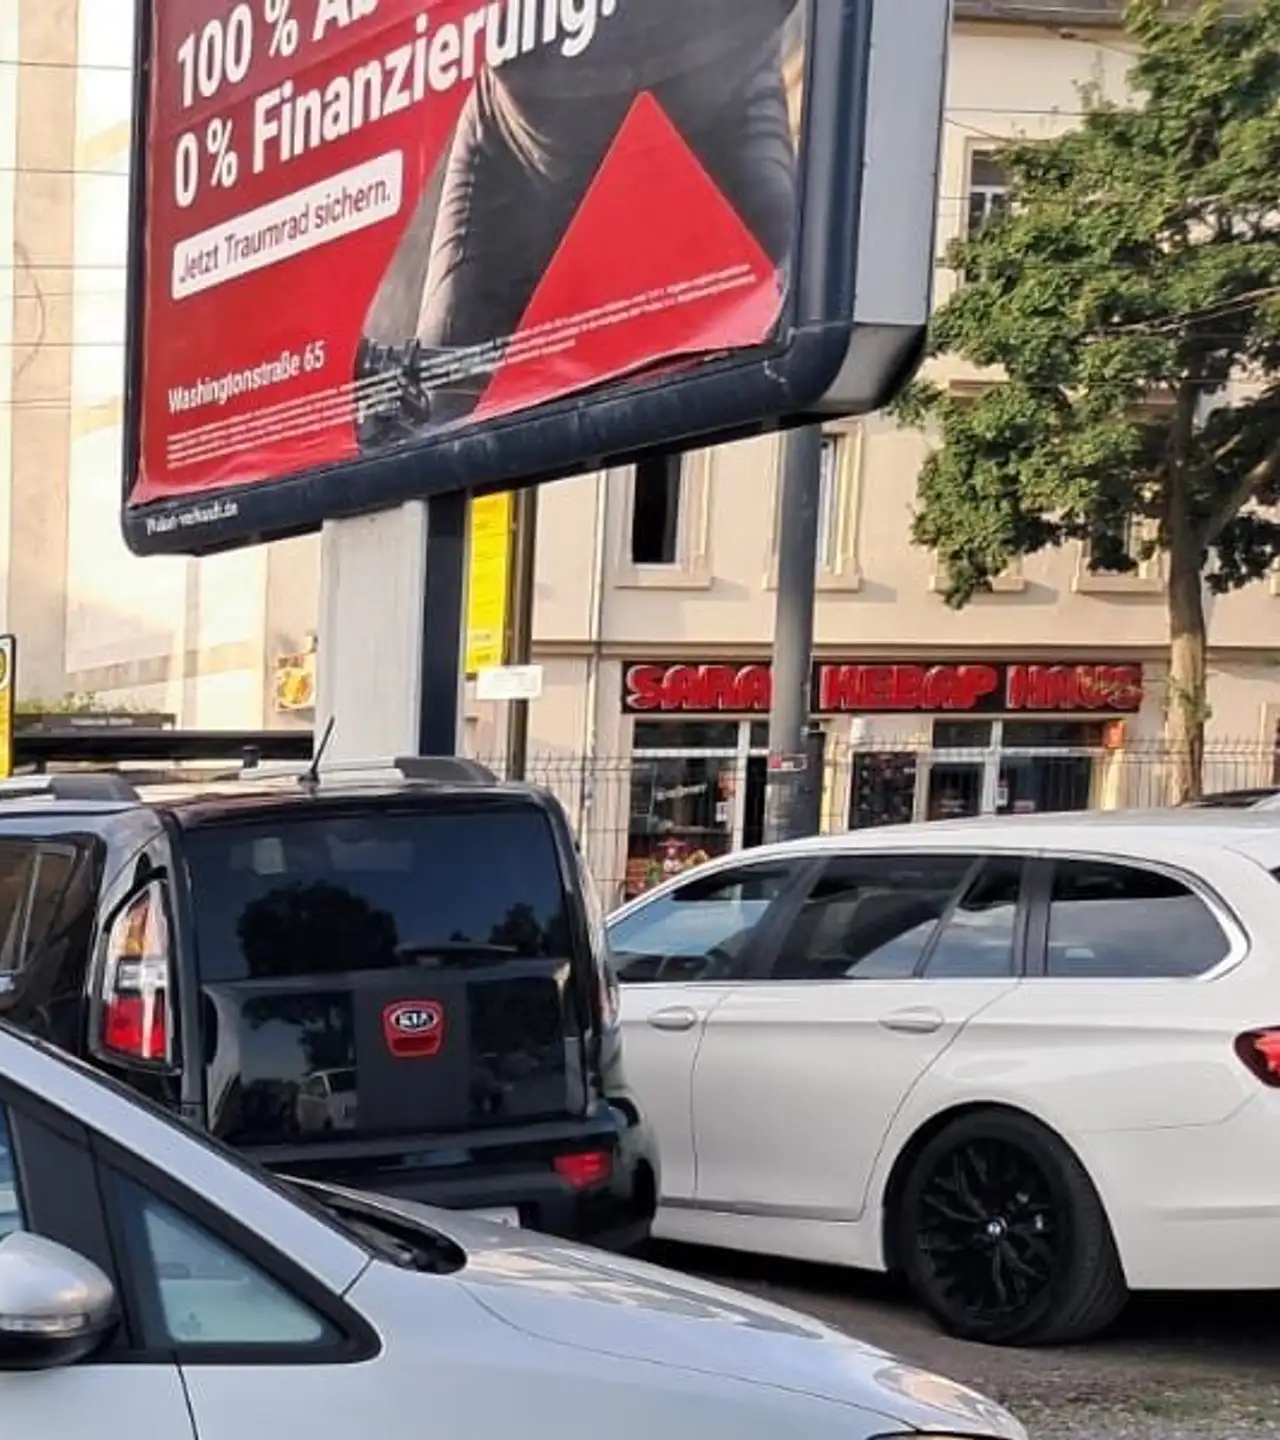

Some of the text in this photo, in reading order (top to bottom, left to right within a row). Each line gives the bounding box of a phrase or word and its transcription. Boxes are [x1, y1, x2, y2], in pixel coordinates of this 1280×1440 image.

[177, 4, 253, 109] 100
[264, 0, 298, 59] %
[175, 131, 199, 208] 0
[206, 117, 238, 189] %
[178, 176, 391, 284] Jetzt Traumrad sichern.
[168, 340, 325, 414] Washingtonstraße 65
[625, 664, 776, 711] SARA
[819, 664, 998, 711] KEBAP
